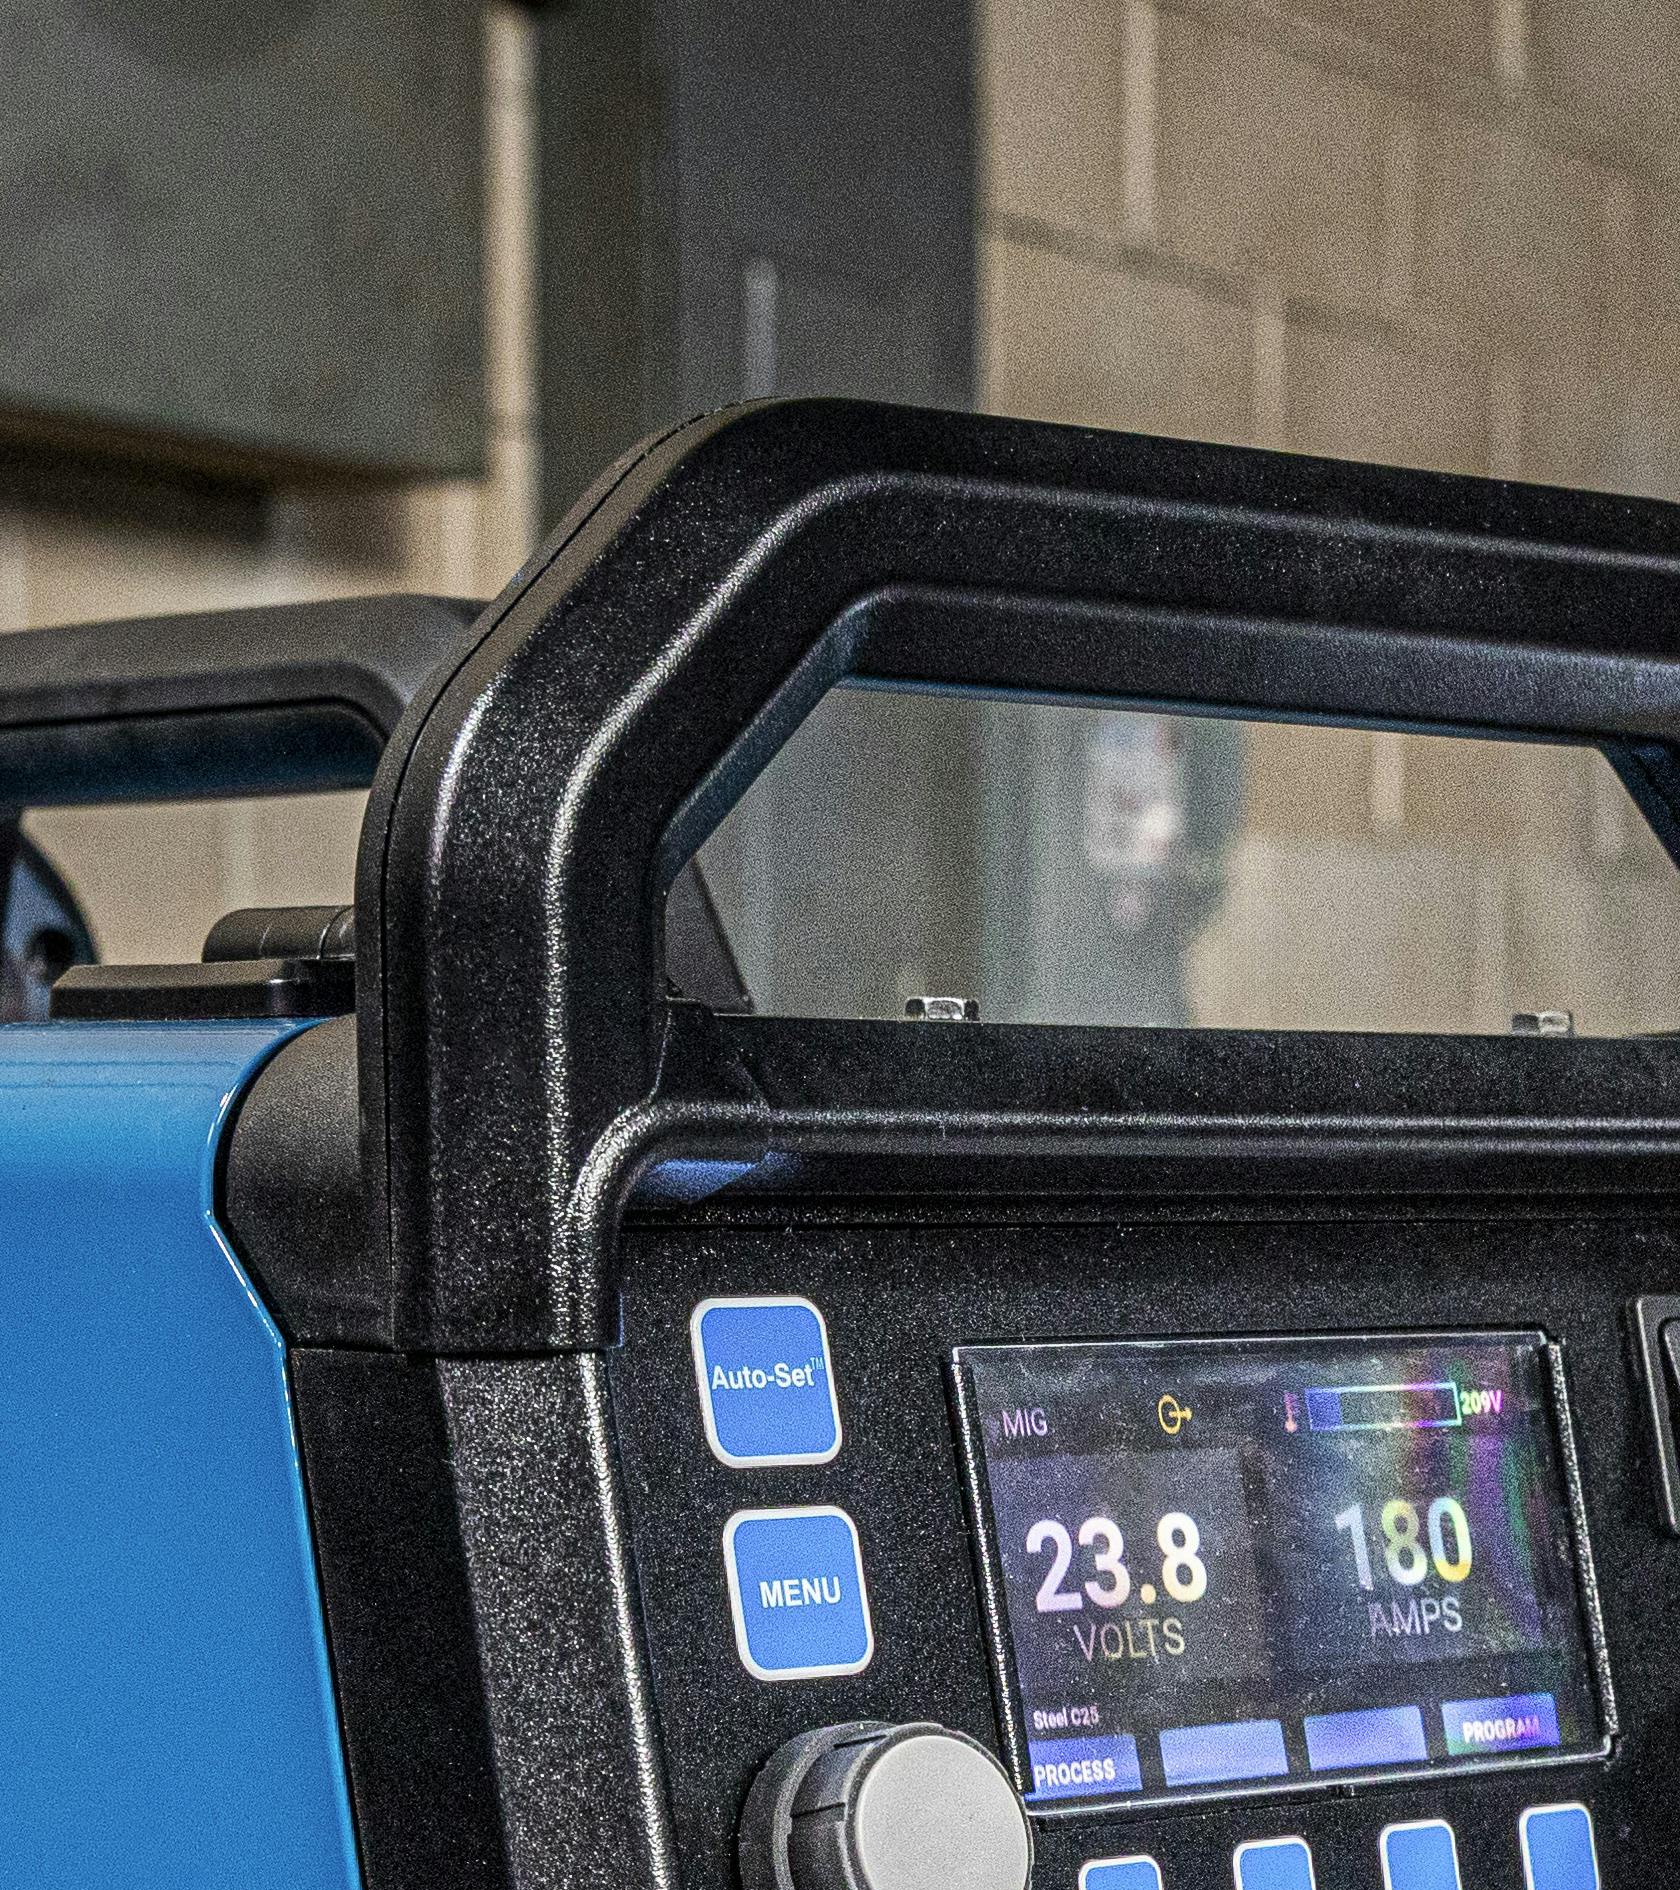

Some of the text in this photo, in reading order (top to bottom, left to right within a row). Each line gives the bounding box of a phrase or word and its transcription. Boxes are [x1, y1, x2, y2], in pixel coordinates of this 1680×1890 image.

[1002, 1408, 1048, 1438] MIG
[1334, 1496, 1473, 1591] 180
[1026, 1512, 1208, 1614] 23.8
[759, 1576, 841, 1609] MENU
[1368, 1595, 1463, 1642] AMPS
[1073, 1617, 1186, 1662] VOLTS
[1033, 1707, 1068, 1731] Steel
[1462, 1714, 1540, 1743] PROGRAM
[1033, 1757, 1117, 1788] PROCESS
